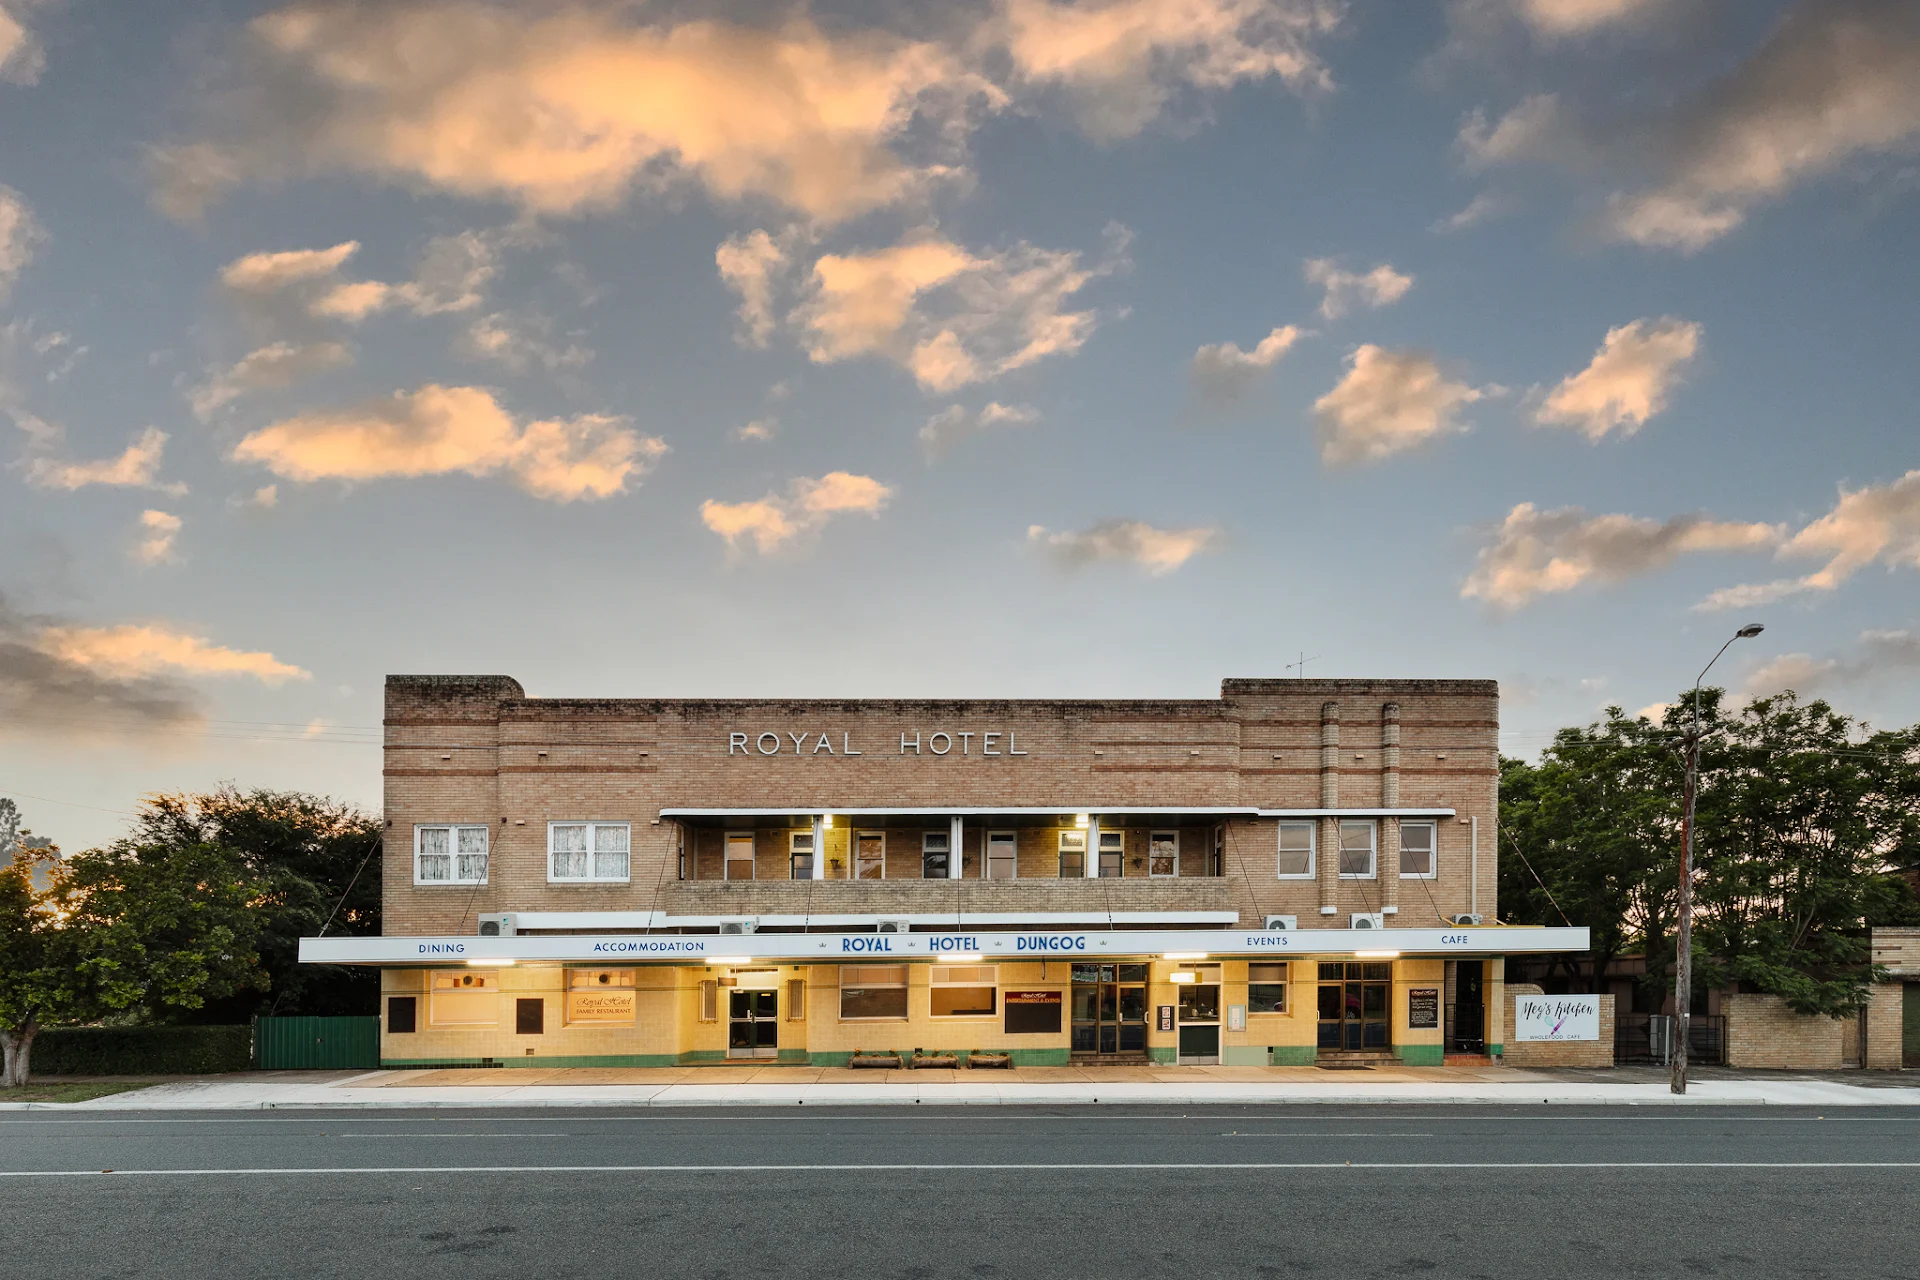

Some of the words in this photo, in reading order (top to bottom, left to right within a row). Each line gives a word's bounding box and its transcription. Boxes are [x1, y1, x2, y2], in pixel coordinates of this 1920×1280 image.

[729, 731, 862, 755] ROYAL
[900, 731, 1028, 755] HOTEL
[842, 937, 893, 952] ROYAL
[929, 936, 980, 951] HOTEL
[1016, 935, 1086, 951] DUNGOG
[1247, 937, 1288, 946] EVENTS
[1441, 935, 1468, 944] CAFE
[418, 943, 465, 953] DINING
[593, 941, 705, 952] ACCOMMODATION
[576, 997, 603, 1008] Royal
[604, 996, 632, 1006] Hotel
[1520, 1001, 1552, 1020] Meg's
[1554, 1001, 1596, 1020] Kitchen
